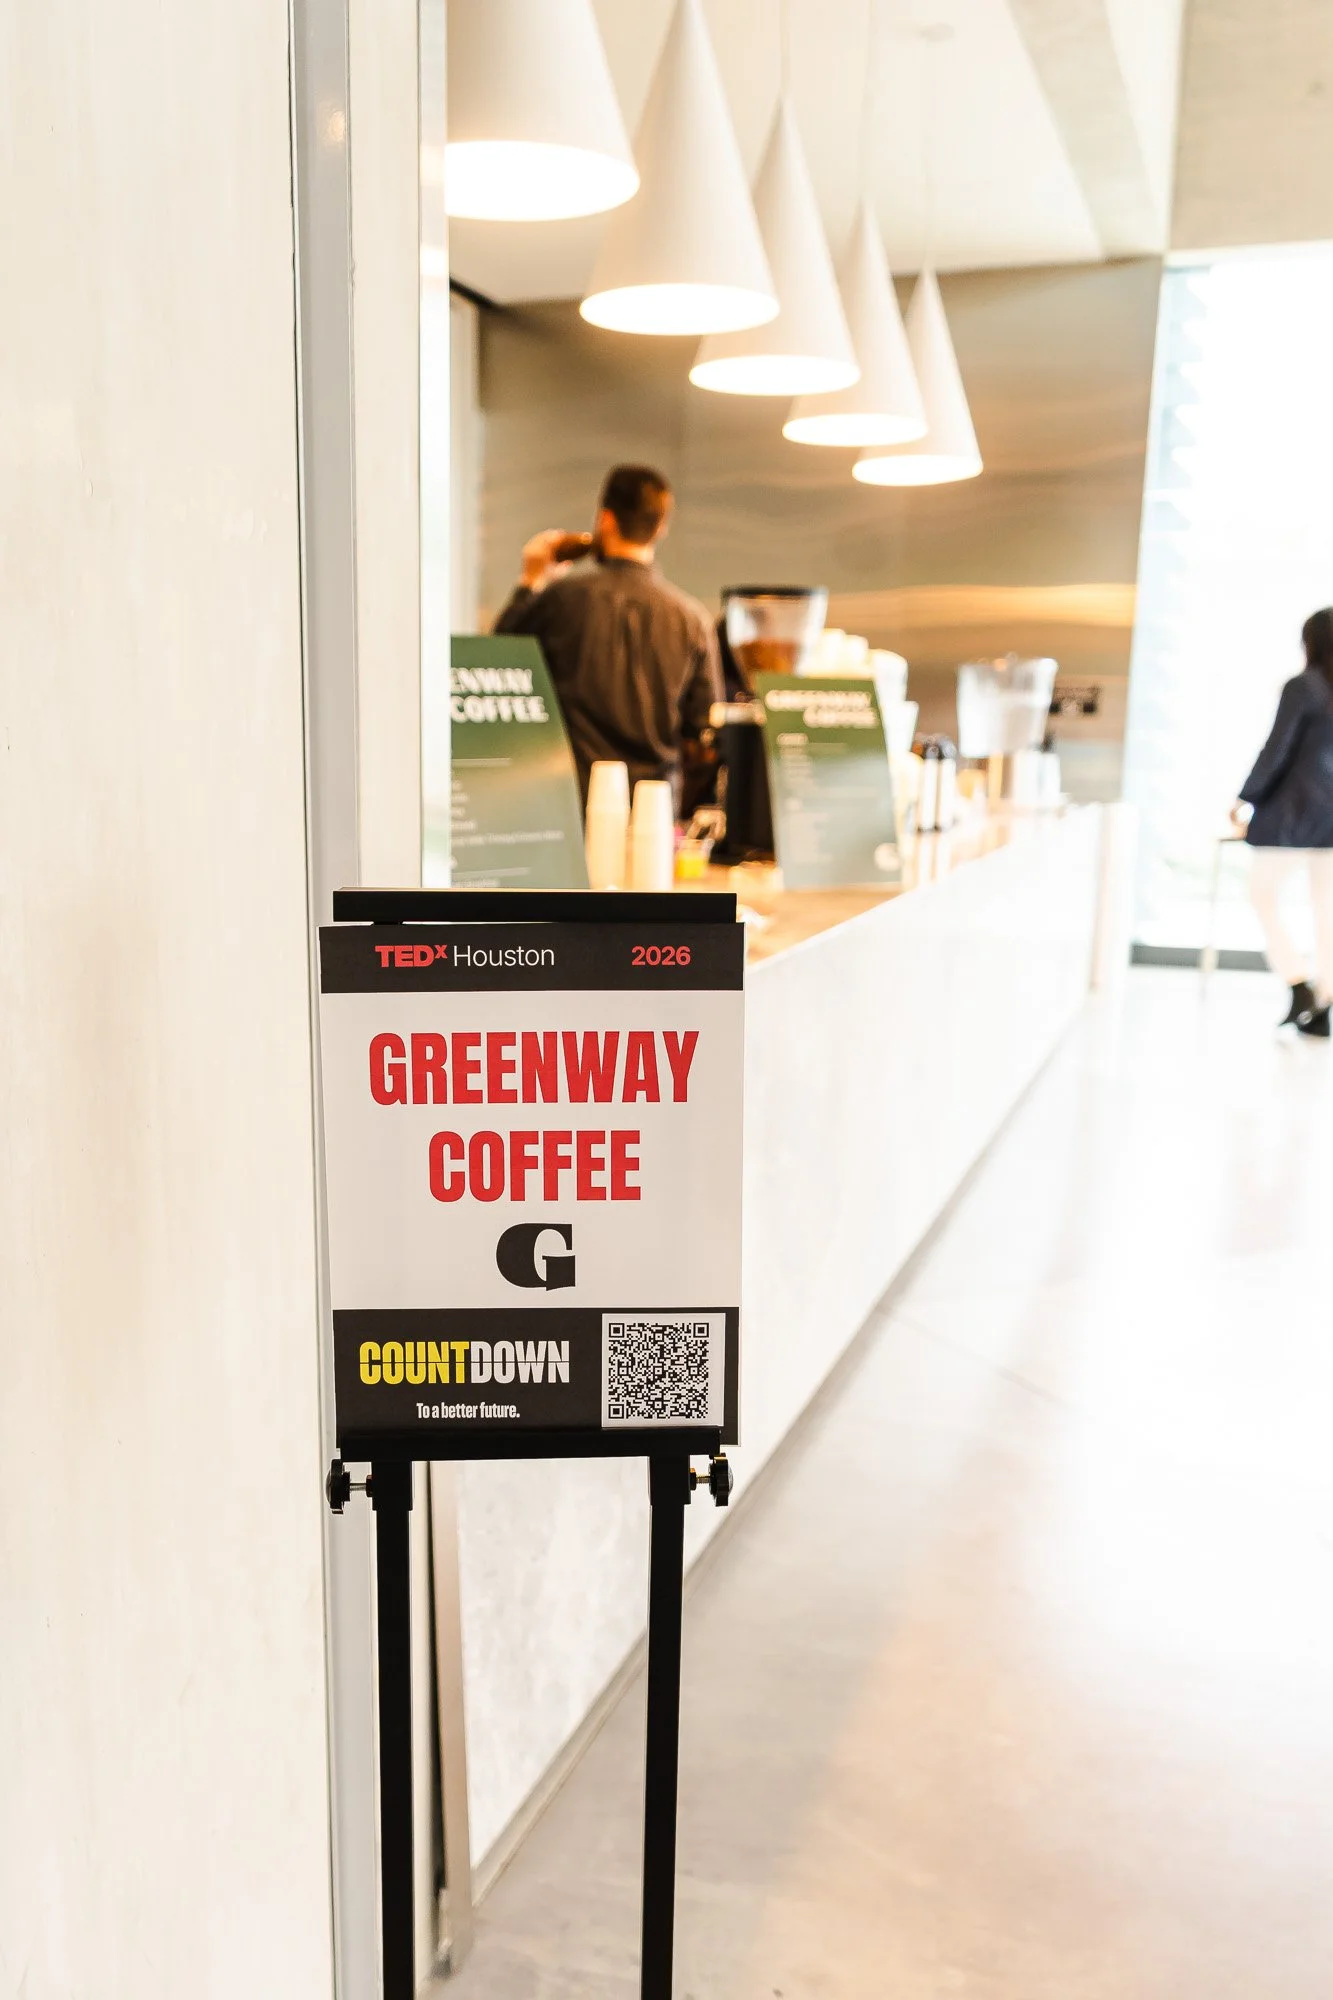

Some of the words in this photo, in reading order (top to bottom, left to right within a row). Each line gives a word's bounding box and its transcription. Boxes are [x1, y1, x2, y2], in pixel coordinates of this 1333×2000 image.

[453, 945, 555, 966] Houston
[631, 945, 691, 966] 2026
[369, 1031, 700, 1105] GREENWAY
[429, 1130, 642, 1202] COFFEE
[496, 1222, 576, 1291] G
[359, 1340, 570, 1384] COUNTDOWN
[416, 1402, 430, 1418] To
[431, 1406, 439, 1418] a
[441, 1402, 478, 1418] better
[479, 1401, 521, 1418] future.
